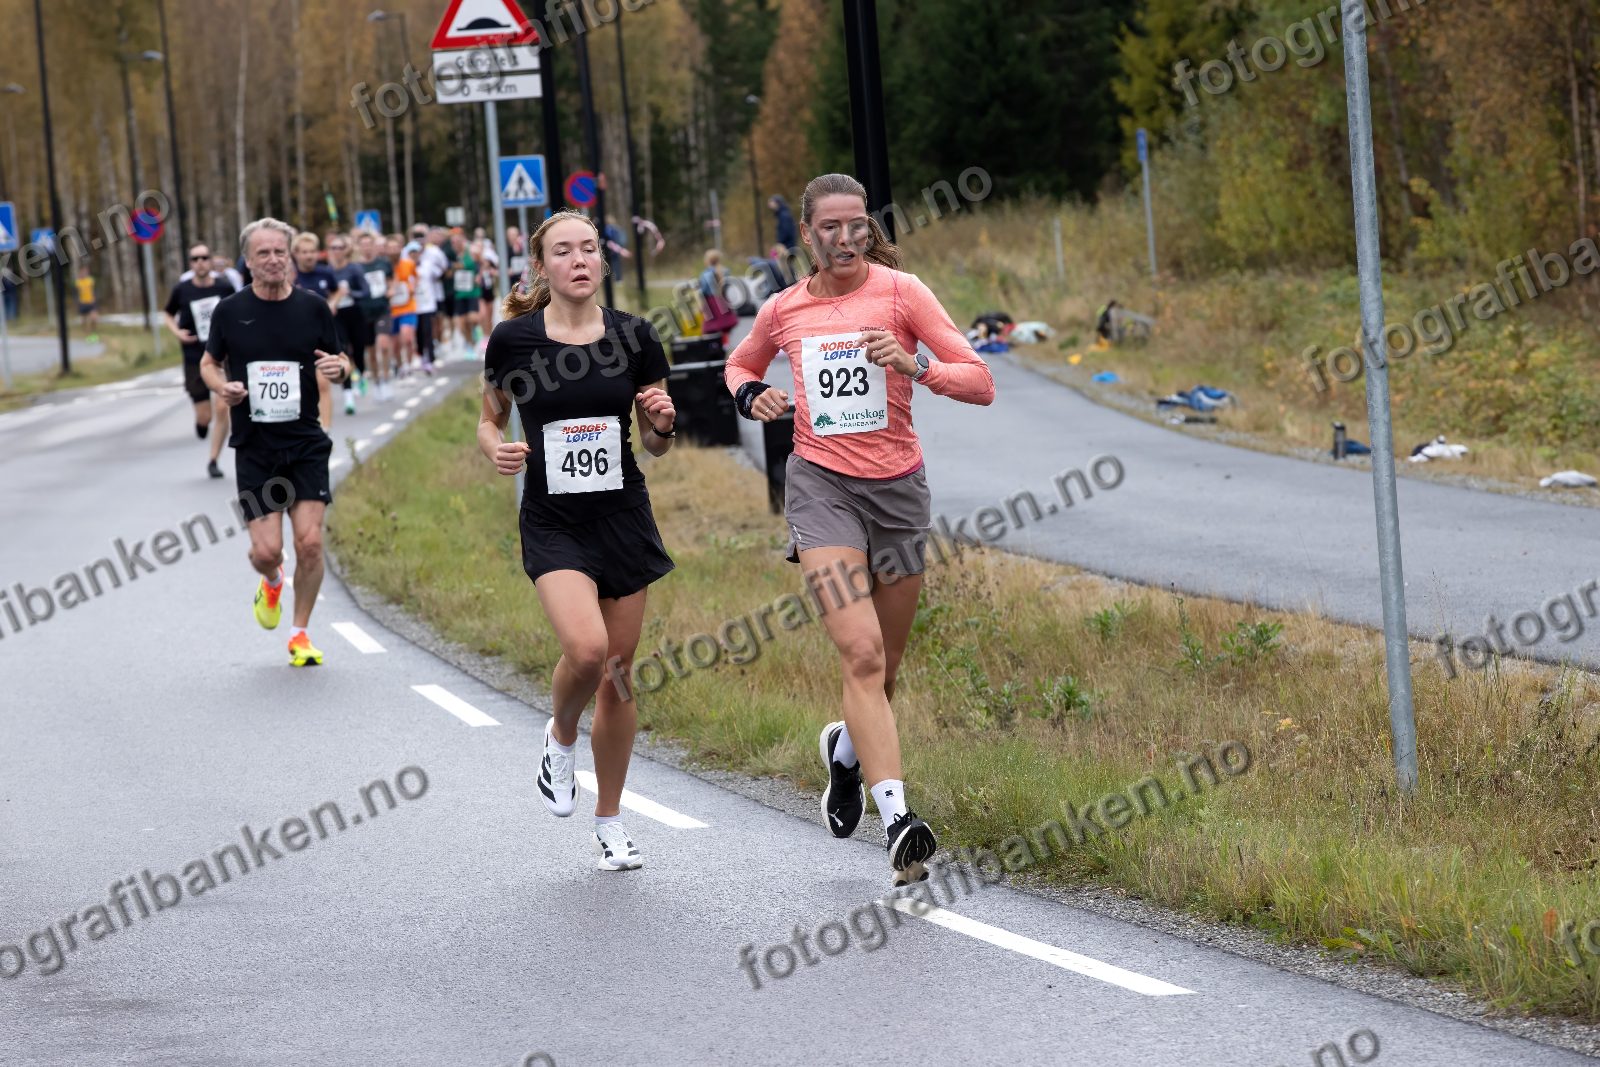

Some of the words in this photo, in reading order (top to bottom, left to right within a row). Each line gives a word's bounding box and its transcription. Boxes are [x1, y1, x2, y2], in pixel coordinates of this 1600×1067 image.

[824, 349, 860, 361] LØPET
[819, 366, 869, 399] 923
[258, 382, 289, 400] 709
[839, 408, 885, 421] Aurskog
[562, 423, 608, 435] NORGES
[565, 431, 602, 443] LØPET
[561, 447, 609, 478] 496
